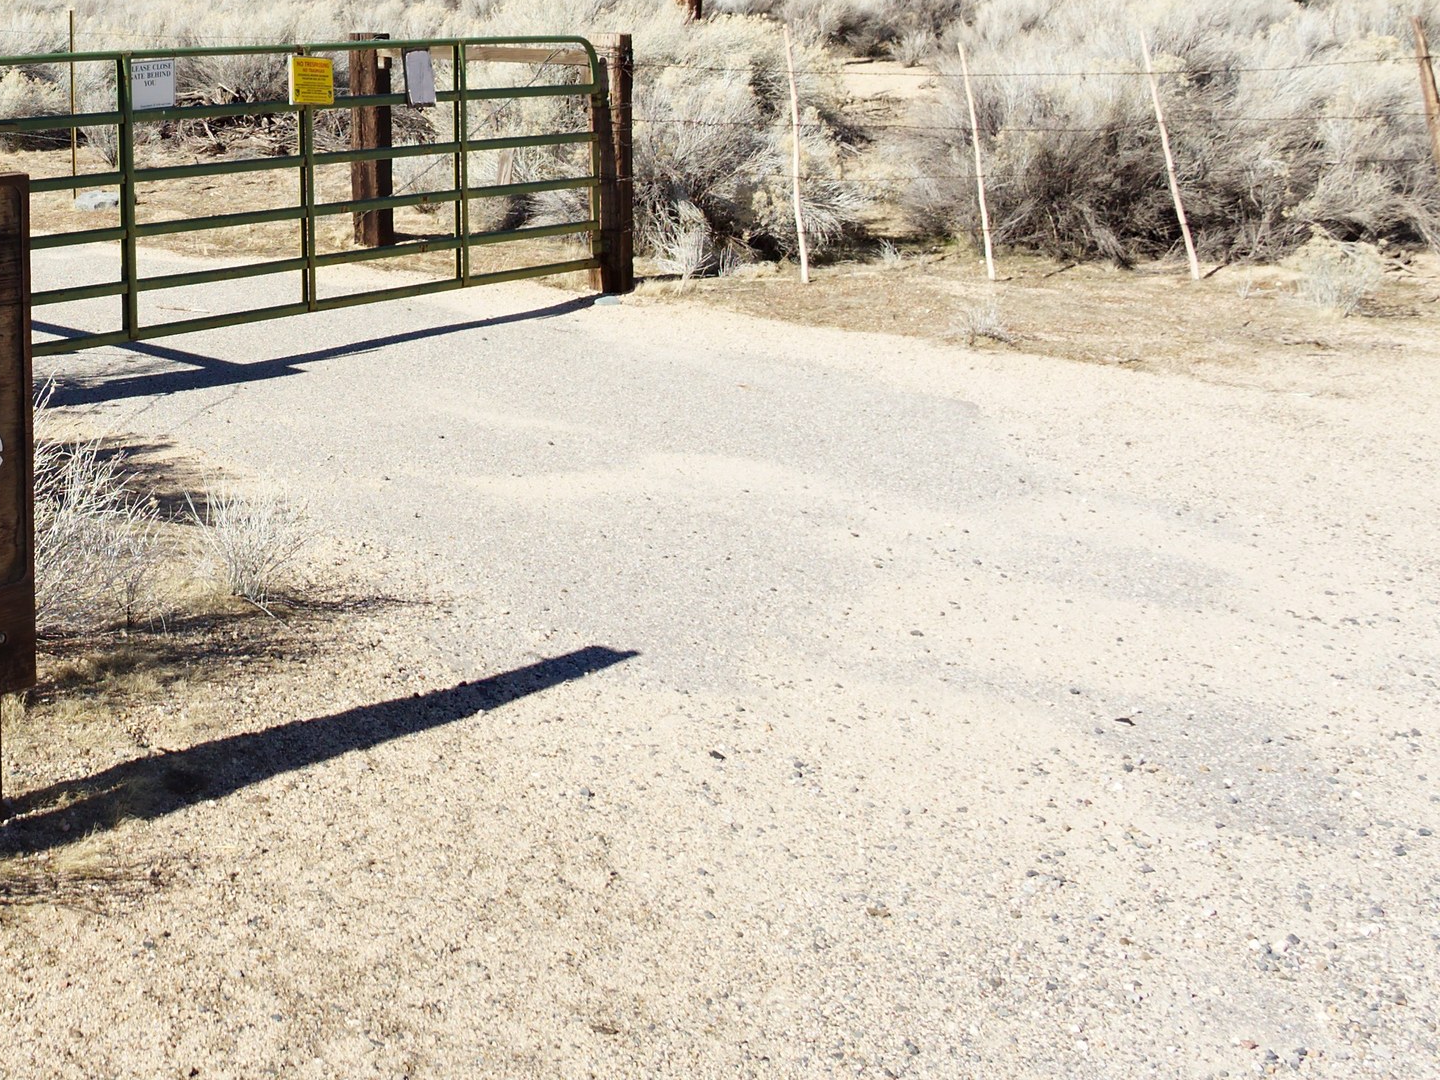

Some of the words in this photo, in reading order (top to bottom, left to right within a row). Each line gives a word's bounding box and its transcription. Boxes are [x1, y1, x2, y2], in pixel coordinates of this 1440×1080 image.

[131, 64, 151, 73] LEASE
[152, 62, 172, 71] CLOSE
[131, 73, 146, 81] ATE
[146, 70, 171, 79] BEHIND
[144, 79, 156, 87] YOU
